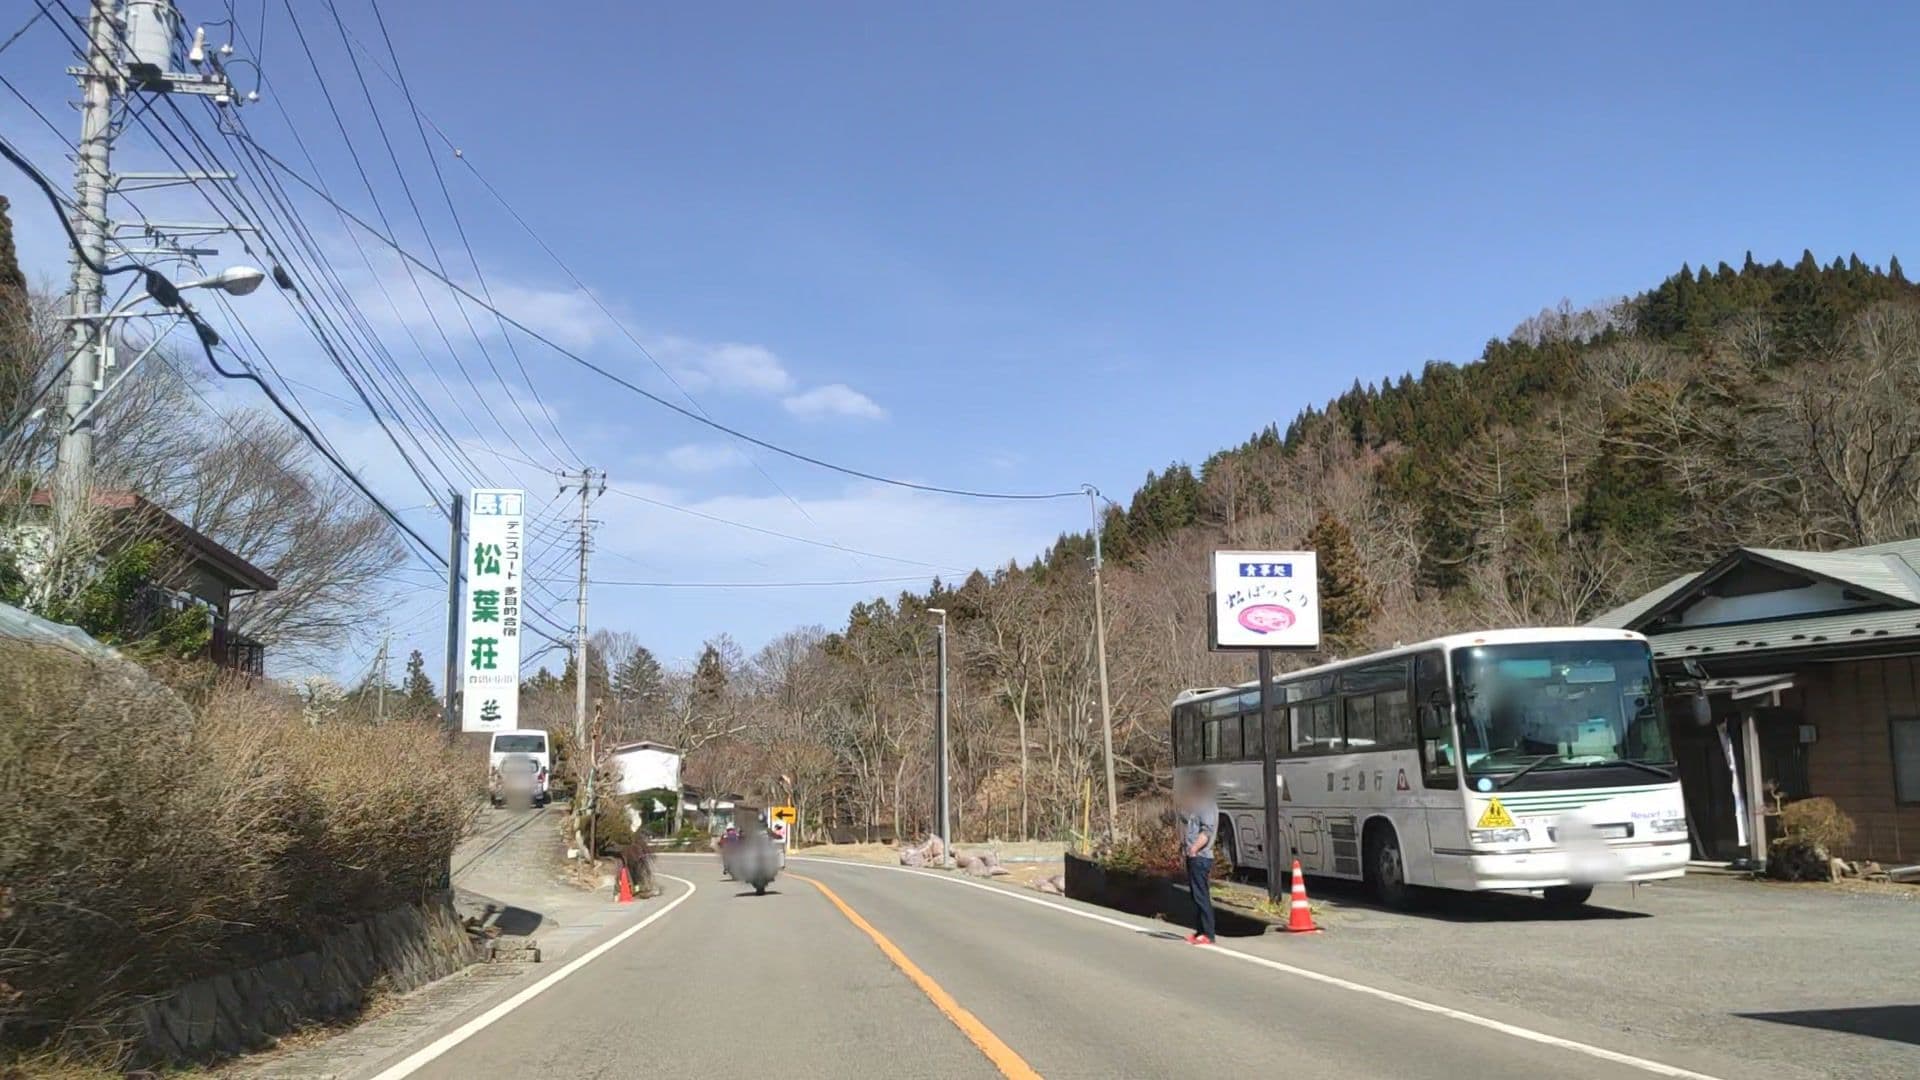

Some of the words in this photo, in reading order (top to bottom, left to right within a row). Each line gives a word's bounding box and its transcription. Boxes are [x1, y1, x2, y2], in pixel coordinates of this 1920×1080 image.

[505, 521, 520, 581] テニスコート
[1246, 564, 1286, 577] 食事処
[471, 542, 502, 670] 松葉荘
